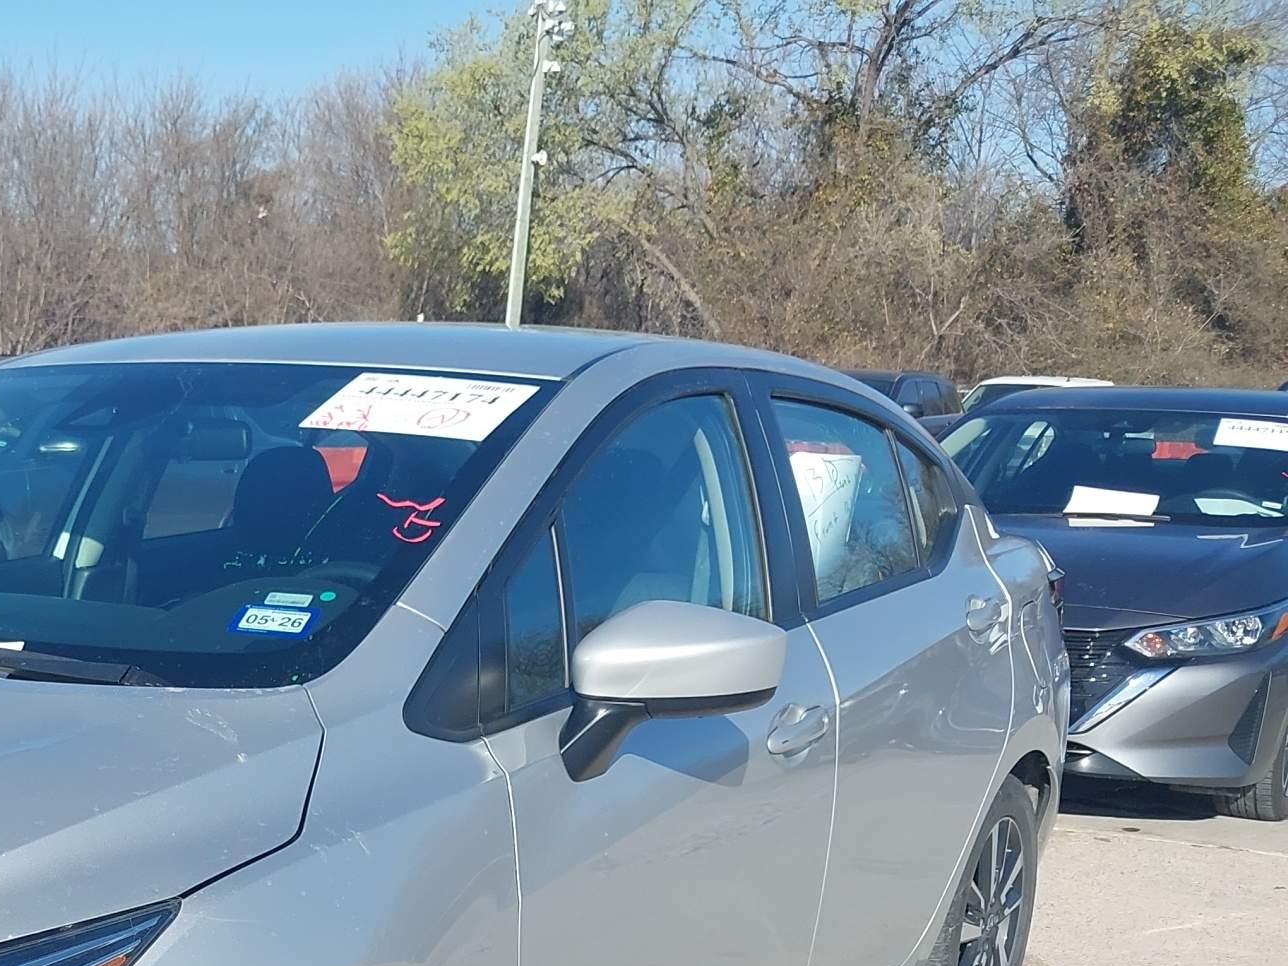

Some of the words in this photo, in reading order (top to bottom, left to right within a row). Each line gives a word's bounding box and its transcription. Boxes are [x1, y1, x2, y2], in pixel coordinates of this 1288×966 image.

[359, 385, 501, 405] 44447174
[245, 613, 271, 625] 05
[278, 616, 304, 628] 26
